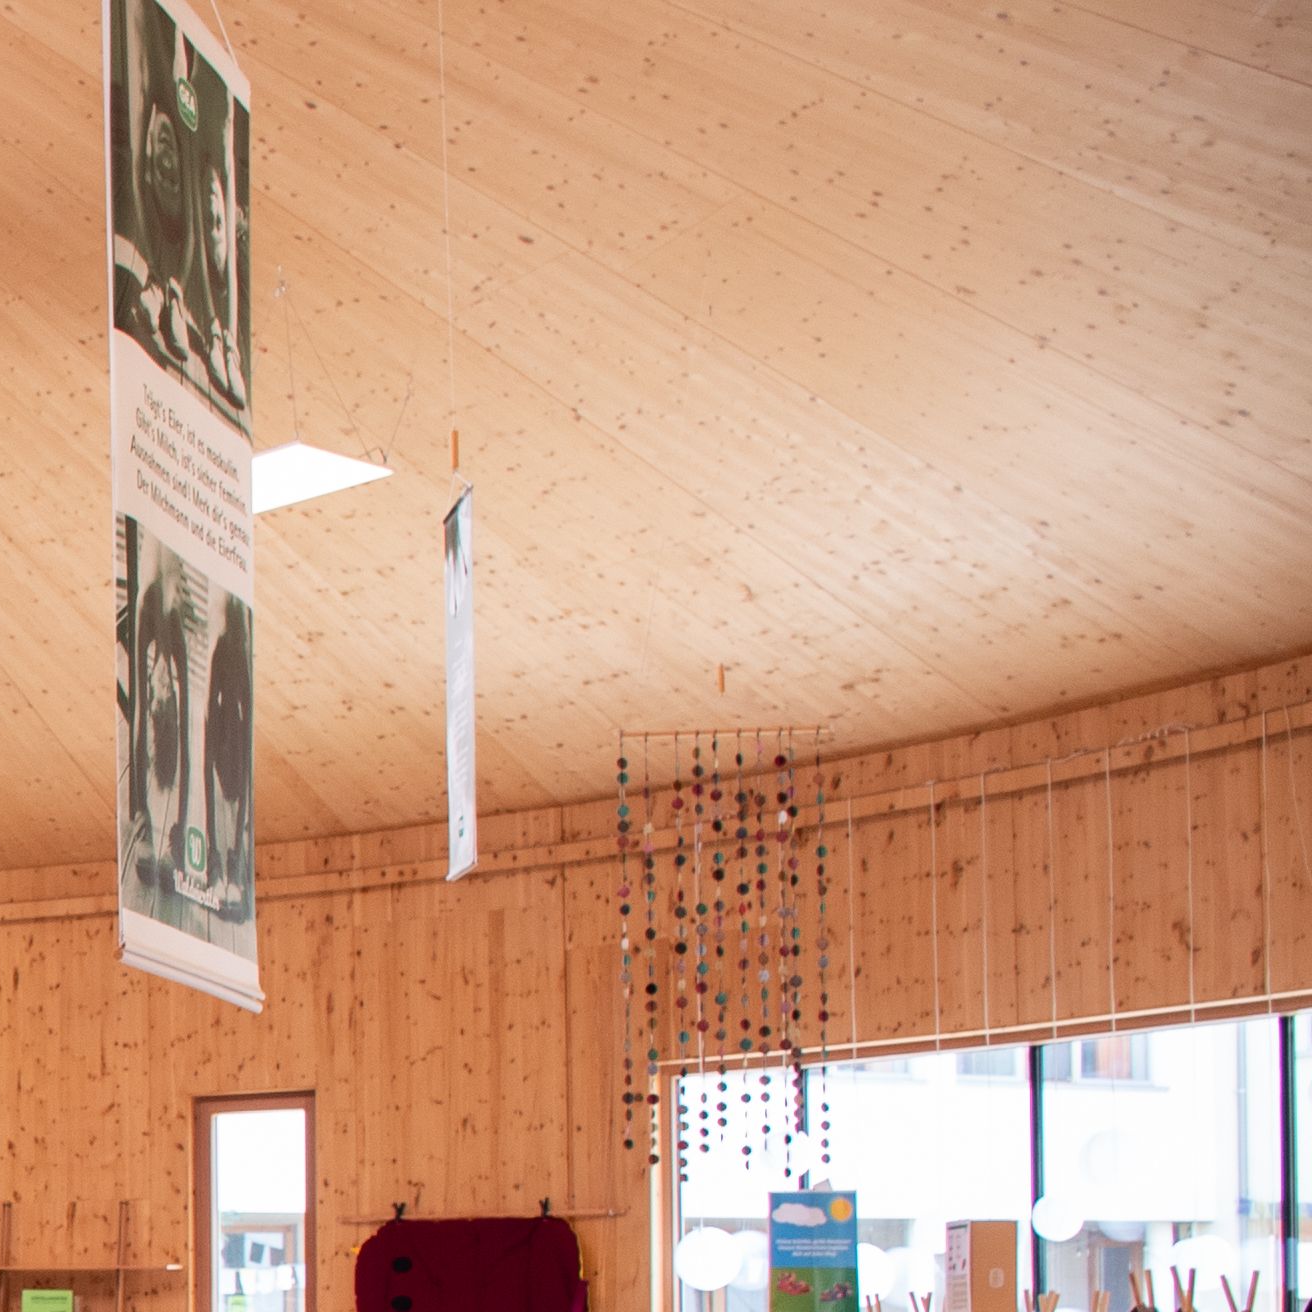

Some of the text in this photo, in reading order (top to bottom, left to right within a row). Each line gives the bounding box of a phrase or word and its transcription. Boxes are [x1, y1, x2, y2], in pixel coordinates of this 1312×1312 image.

[157, 428, 180, 466] Milch,
[197, 466, 217, 493] sicher
[169, 407, 185, 440] Eier,
[187, 424, 196, 448] ist
[130, 434, 170, 485] Ausnahmen
[192, 486, 210, 517] Merk
[137, 469, 149, 495] Der
[150, 480, 189, 530] Milchmann
[191, 519, 204, 542] und
